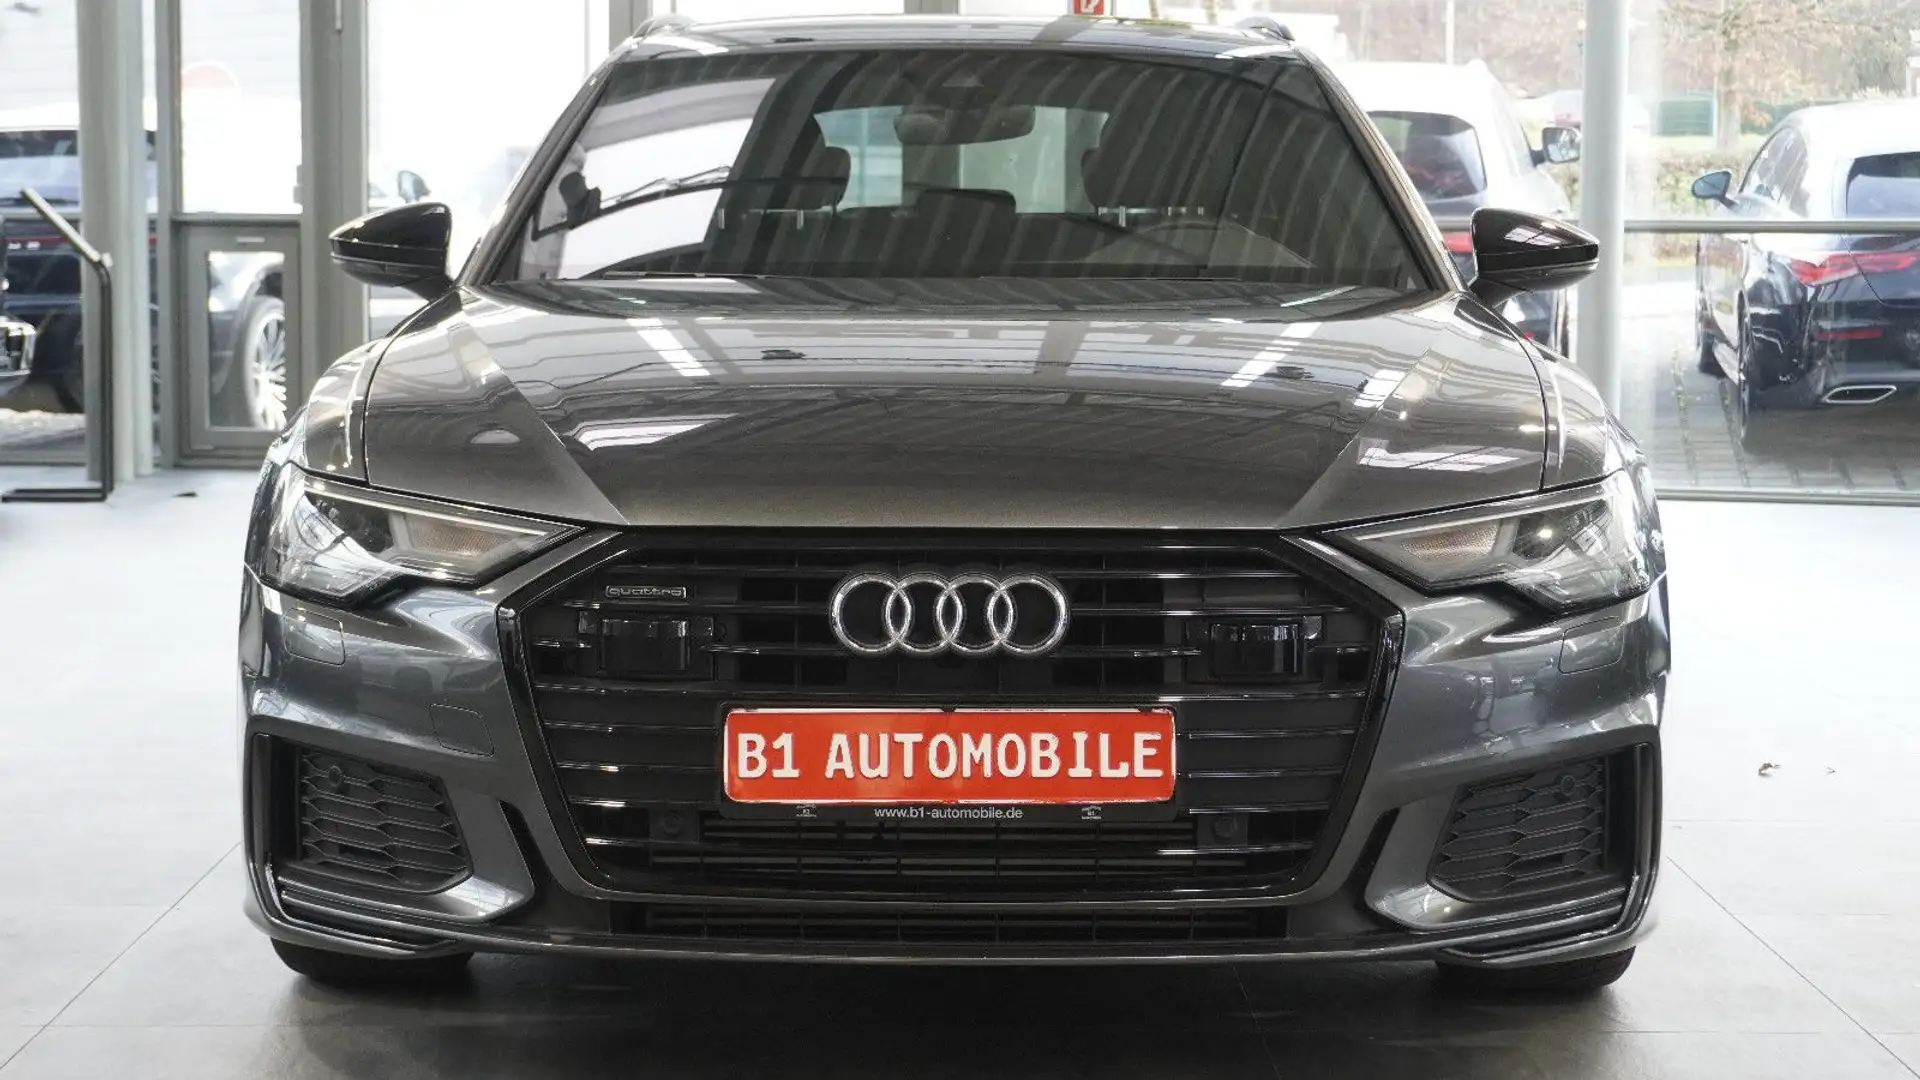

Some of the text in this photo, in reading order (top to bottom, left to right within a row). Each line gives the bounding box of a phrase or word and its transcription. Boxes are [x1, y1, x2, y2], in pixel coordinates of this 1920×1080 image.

[608, 587, 682, 597] quattro
[737, 732, 1164, 779] B1 AUTOMOBILE
[874, 807, 1023, 819] www.b1-automobile.de
